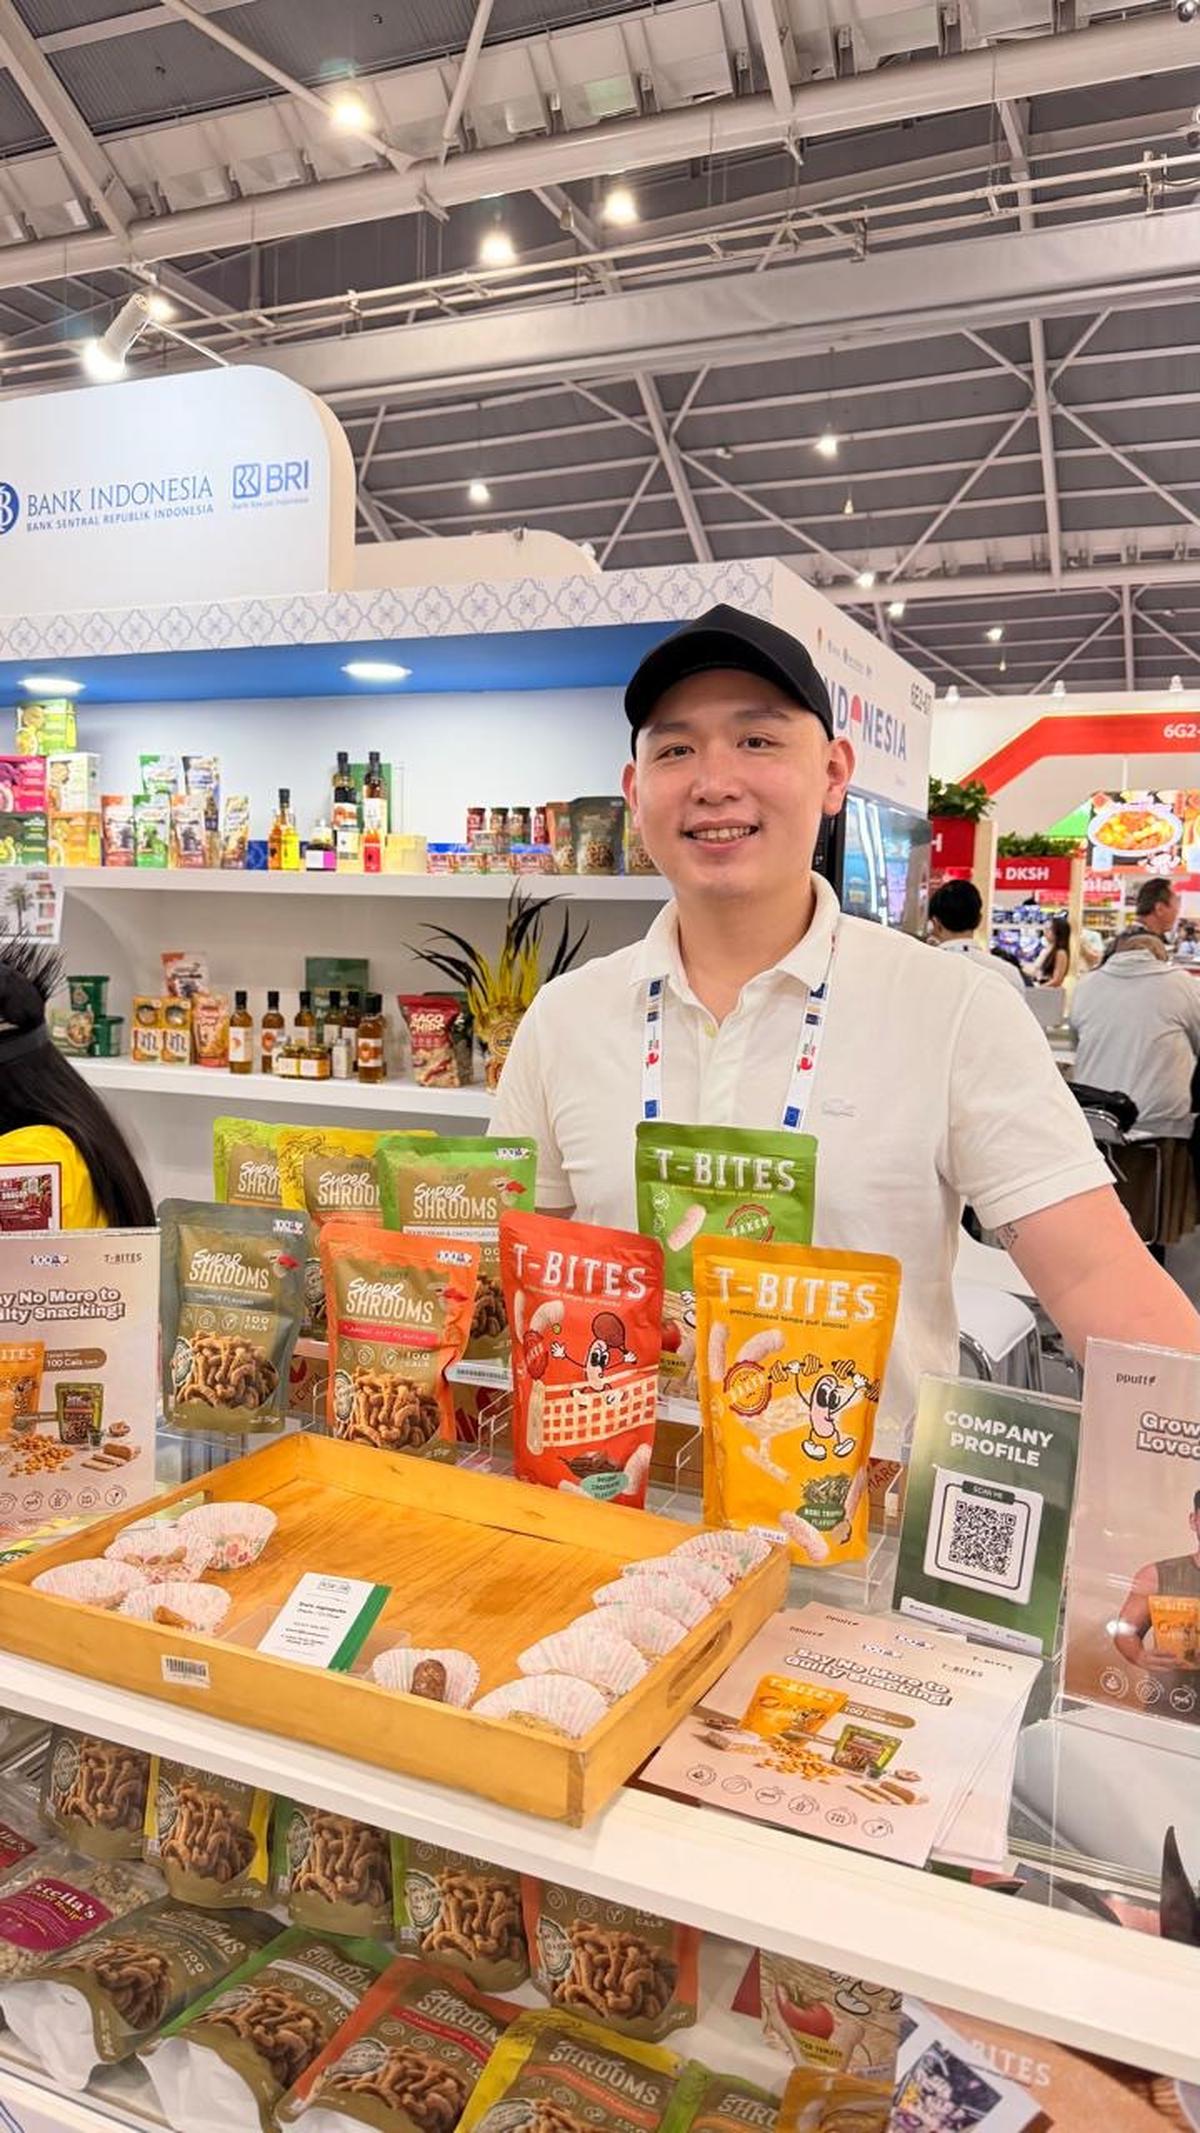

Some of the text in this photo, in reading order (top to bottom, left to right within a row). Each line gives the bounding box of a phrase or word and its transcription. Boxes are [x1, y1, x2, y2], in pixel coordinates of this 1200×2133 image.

[266, 460, 309, 493] BRI
[27, 475, 213, 517] BANK INDONESIA
[27, 520, 53, 532] BANK
[56, 515, 100, 529] SENTRAL
[103, 510, 151, 525] REPUBLIK
[153, 503, 214, 520] INDONESIA
[1005, 866, 1050, 881] DKSH
[656, 1149, 796, 1193] T-BITES
[318, 1183, 380, 1206] SHROO
[413, 1196, 498, 1220] SHROOMS
[104, 1252, 143, 1263] T-BITES
[513, 1243, 647, 1301] T-BITES
[189, 1262, 270, 1290] SHROOMS
[19, 1290, 46, 1305] No
[48, 1289, 97, 1304] More
[99, 1287, 121, 1301] to
[346, 1292, 435, 1323] SHROOMS
[713, 1265, 878, 1322] T-BITES
[33, 1302, 126, 1321] Snacking!
[943, 1409, 1054, 1449] COMPANY
[950, 1431, 1041, 1467] PROFILE
[784, 1654, 953, 1706] Guilty Snacking!
[795, 1648, 951, 1695] Say No More to
[549, 2043, 663, 2106] SHROOMS
